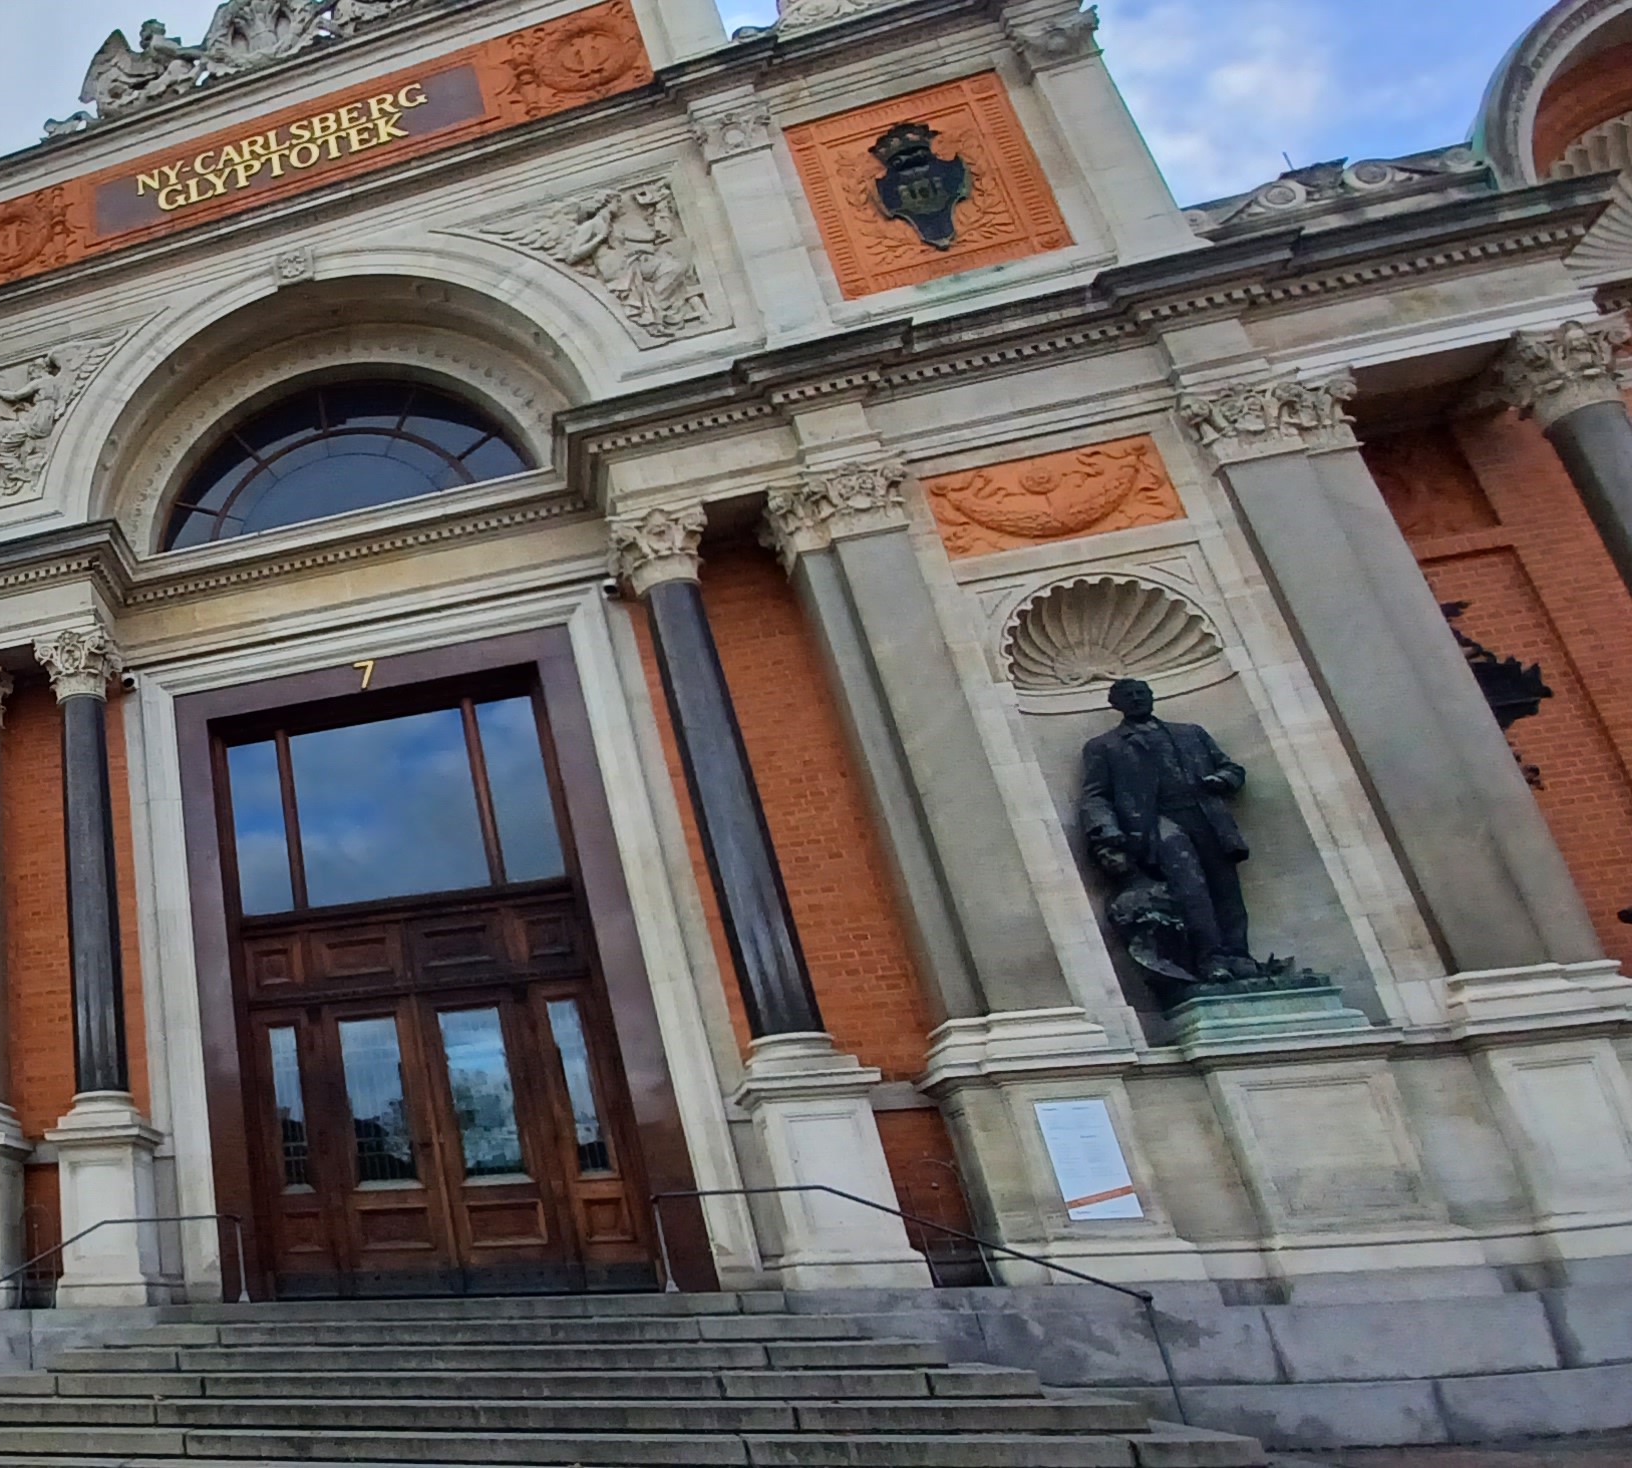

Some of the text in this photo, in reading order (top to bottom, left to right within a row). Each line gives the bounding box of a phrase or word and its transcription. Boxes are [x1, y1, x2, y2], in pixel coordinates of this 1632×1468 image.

[135, 83, 428, 196] NY-CARLSBERG
[157, 112, 410, 211] GLYPTOTEK
[353, 660, 374, 689] 7
